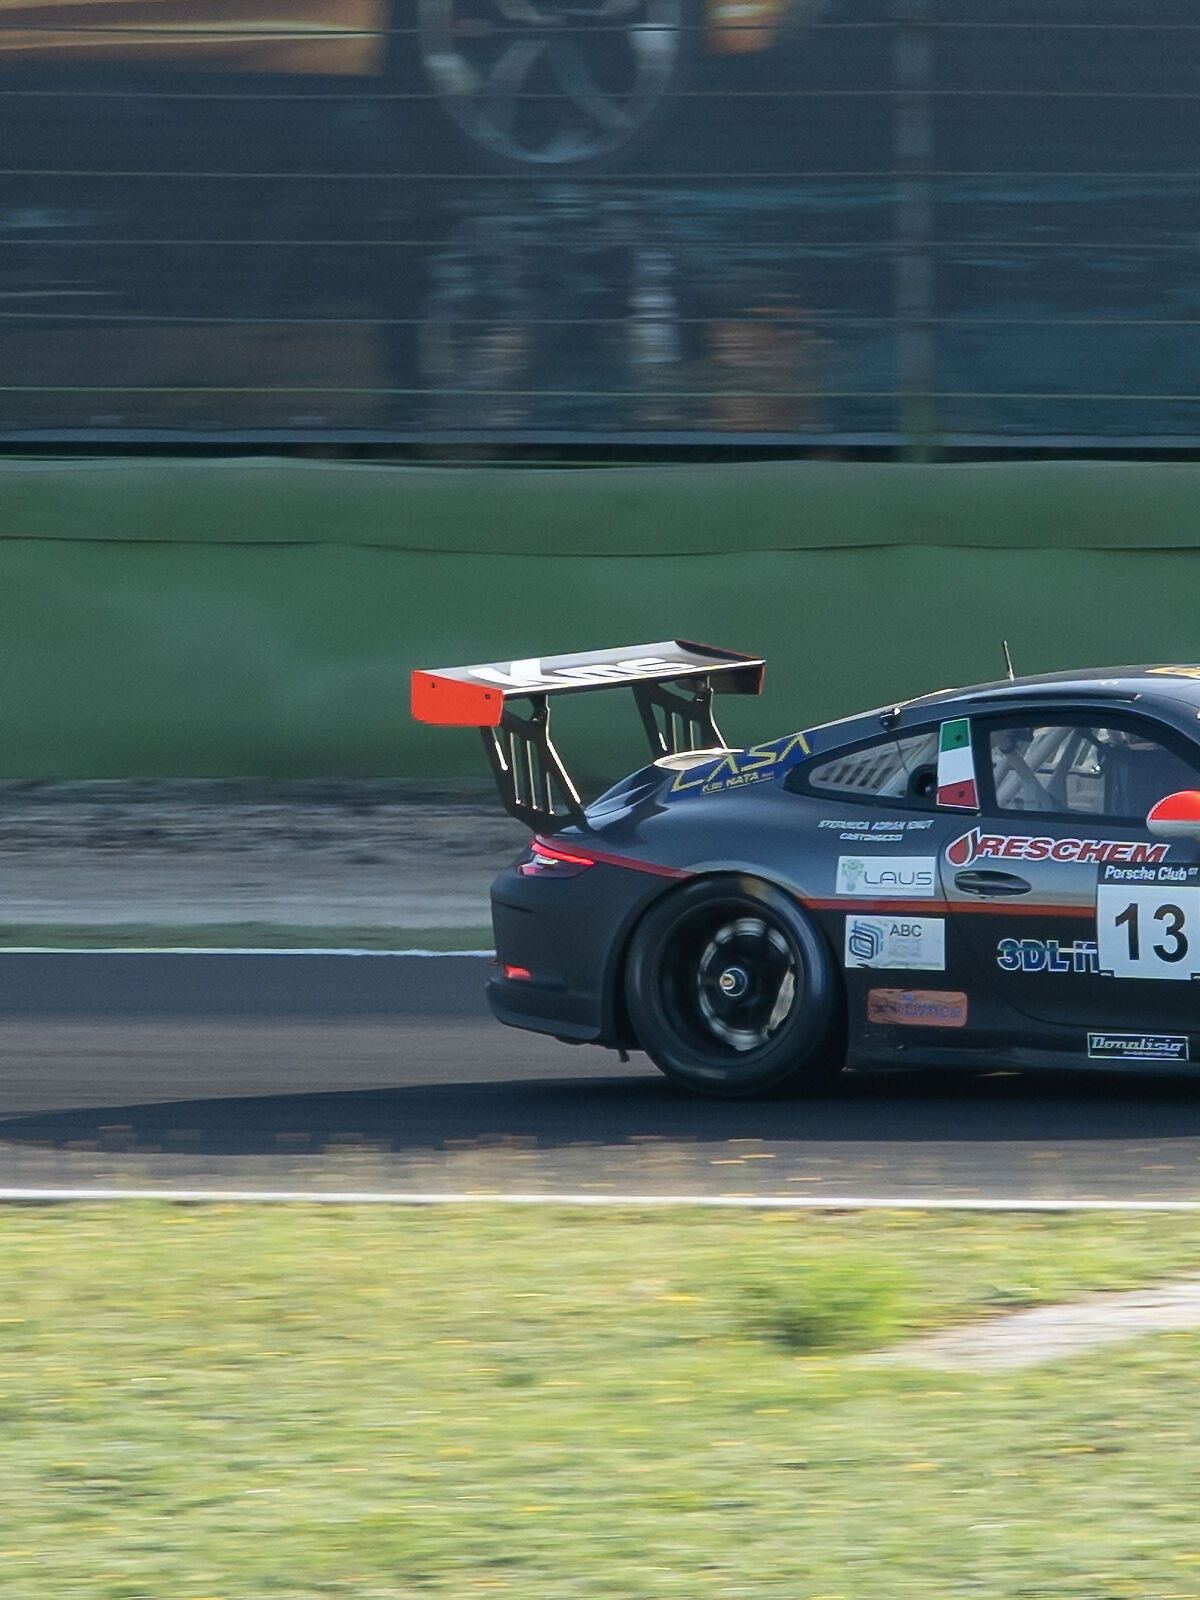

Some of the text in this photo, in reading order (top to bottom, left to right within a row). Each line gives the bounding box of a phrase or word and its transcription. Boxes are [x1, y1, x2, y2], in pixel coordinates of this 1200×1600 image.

[976, 834, 1171, 863] RESCHEM
[863, 871, 932, 886] LAUS
[1104, 866, 1156, 881] Porsche
[1158, 867, 1187, 881] Club
[889, 924, 922, 937] ABC
[1114, 902, 1189, 963] 13
